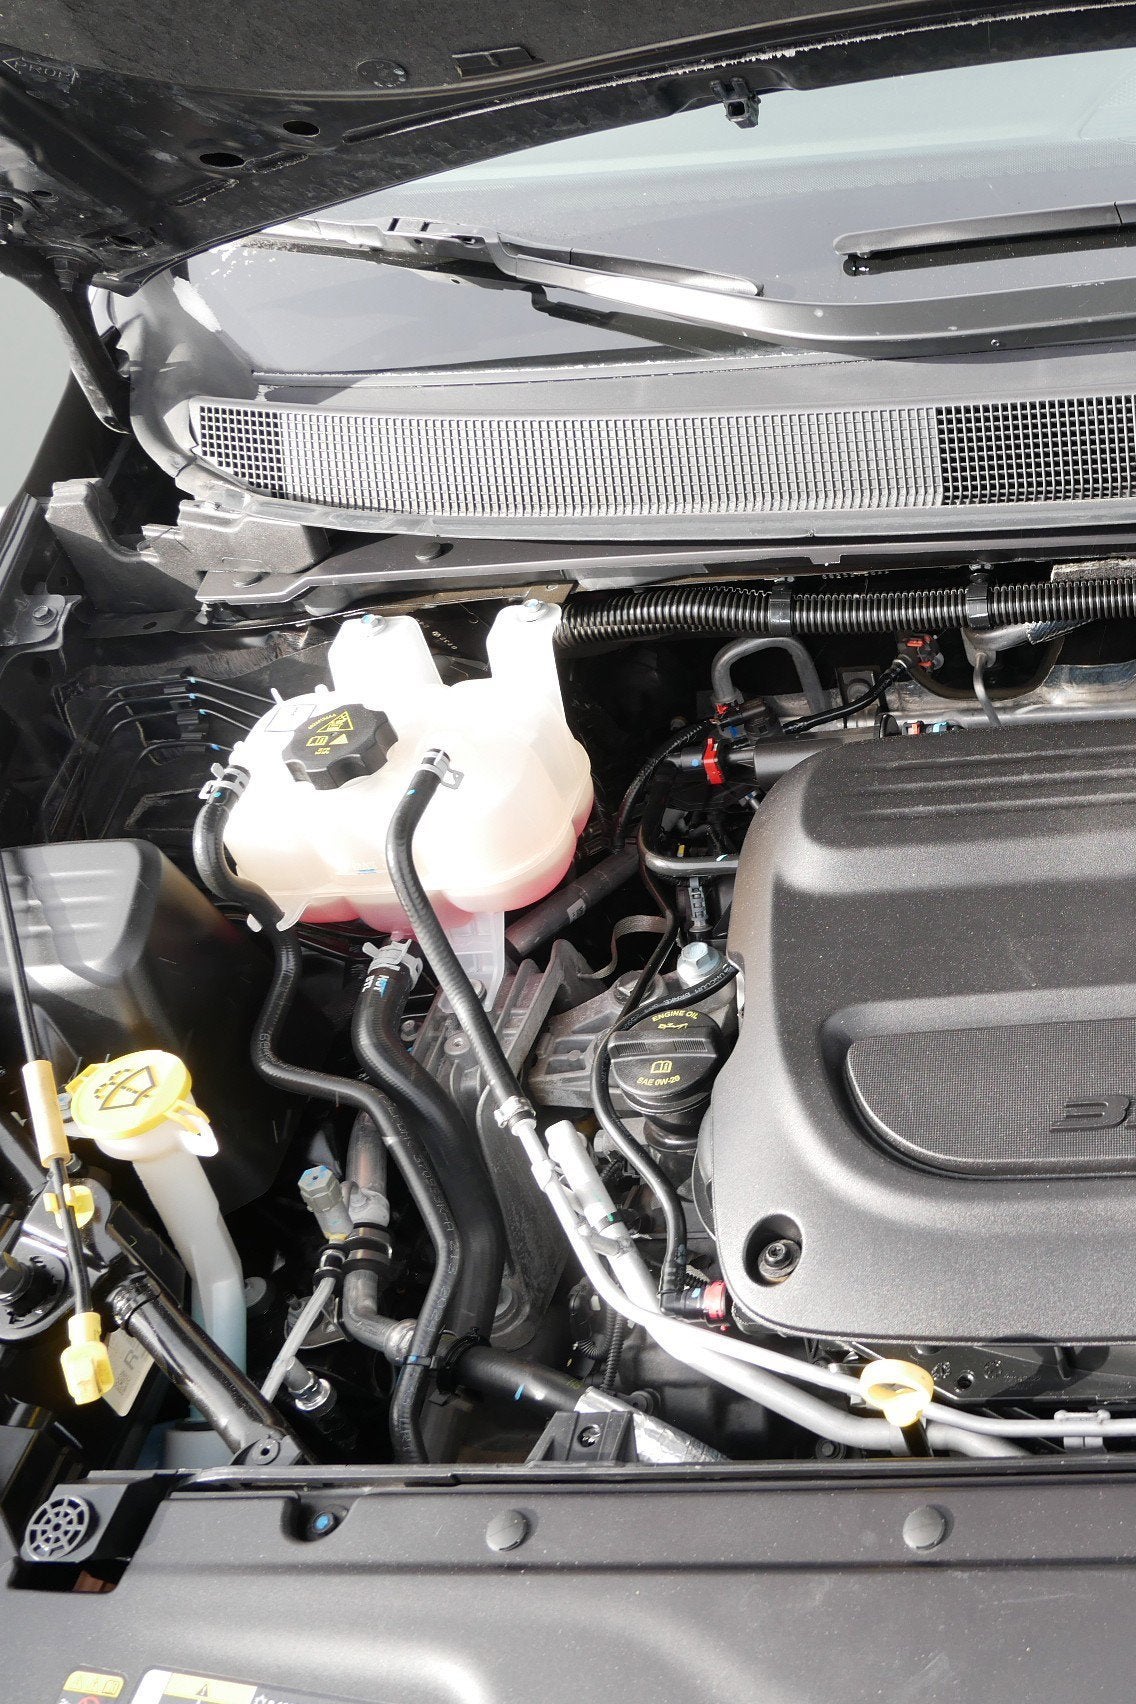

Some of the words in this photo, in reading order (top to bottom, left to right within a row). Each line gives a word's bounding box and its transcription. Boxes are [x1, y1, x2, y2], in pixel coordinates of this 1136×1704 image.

[652, 1010, 686, 1022] ENGINE
[686, 1011, 699, 1020] OIL
[636, 1076, 655, 1086] SAE
[655, 1074, 681, 1086] 0W-20
